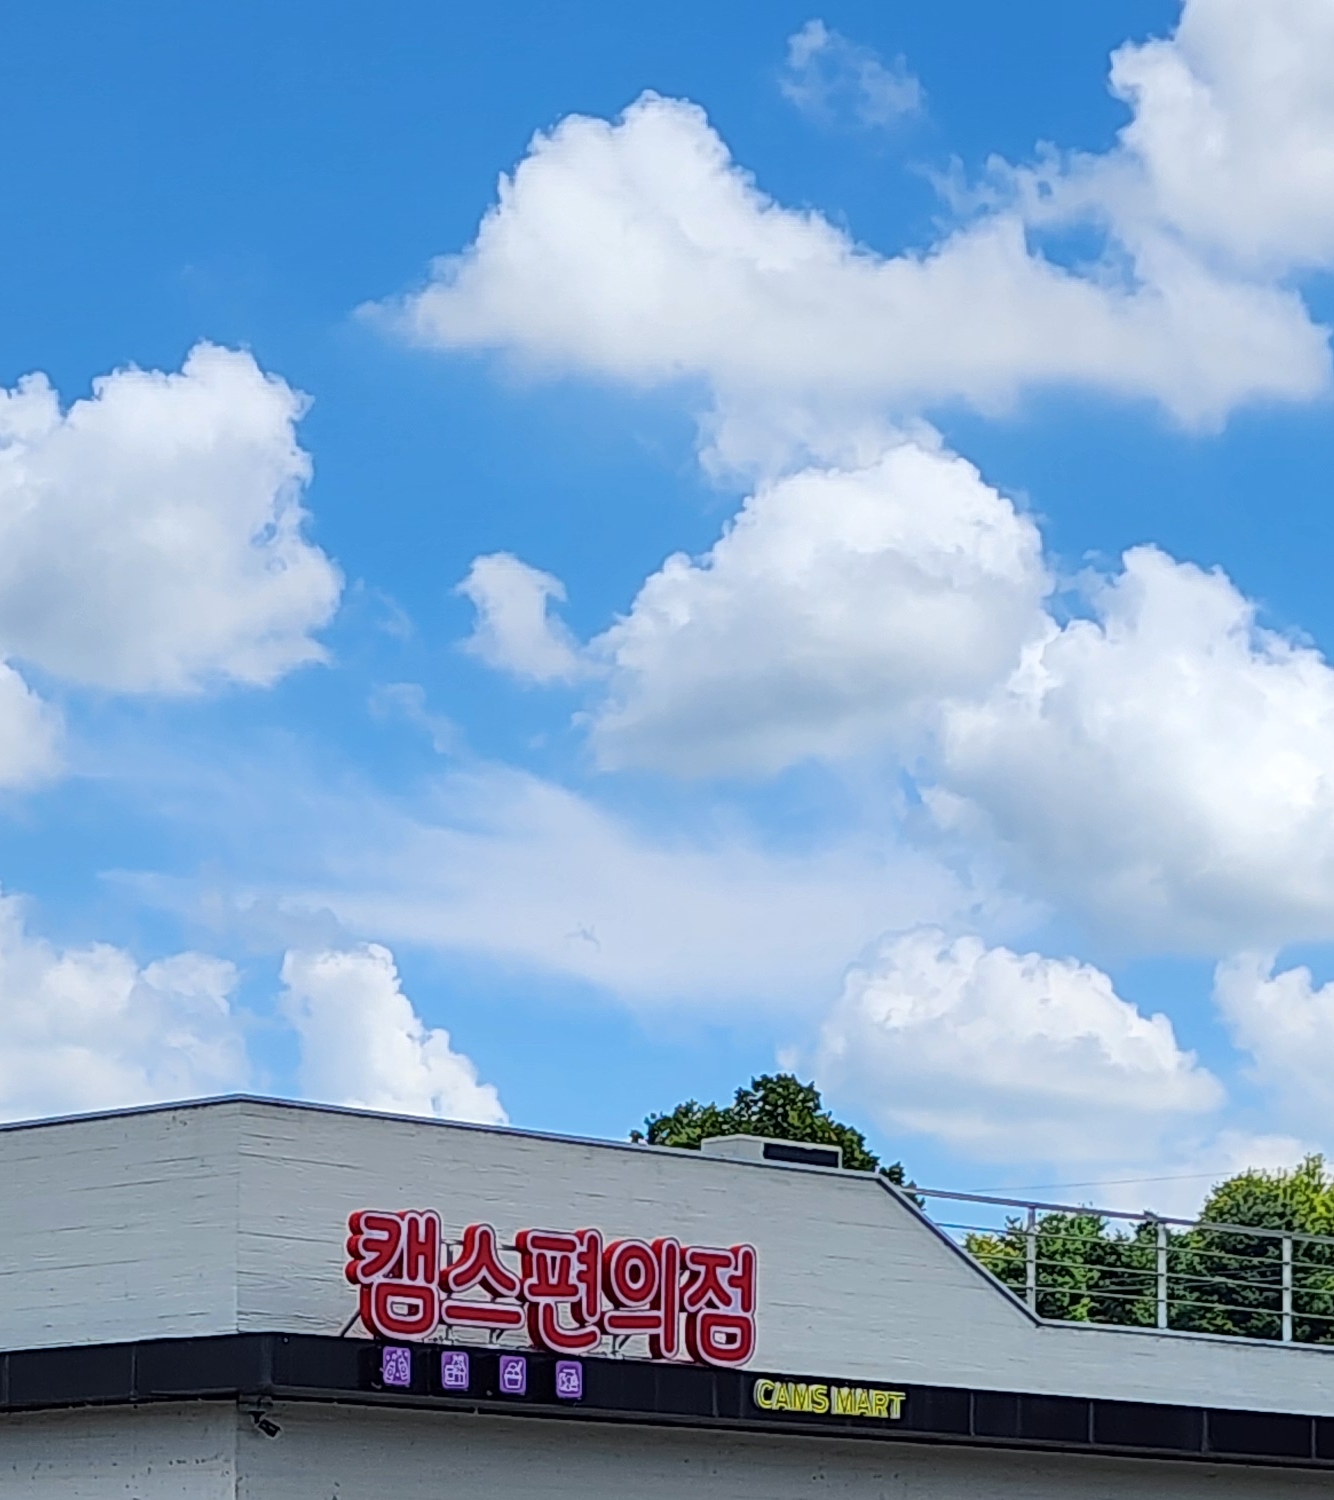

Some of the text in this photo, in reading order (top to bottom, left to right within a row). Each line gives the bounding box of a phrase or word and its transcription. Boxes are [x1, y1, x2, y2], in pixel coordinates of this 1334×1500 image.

[346, 1209, 756, 1367] 캠스편의점
[754, 1379, 906, 1419] CAMS MART
